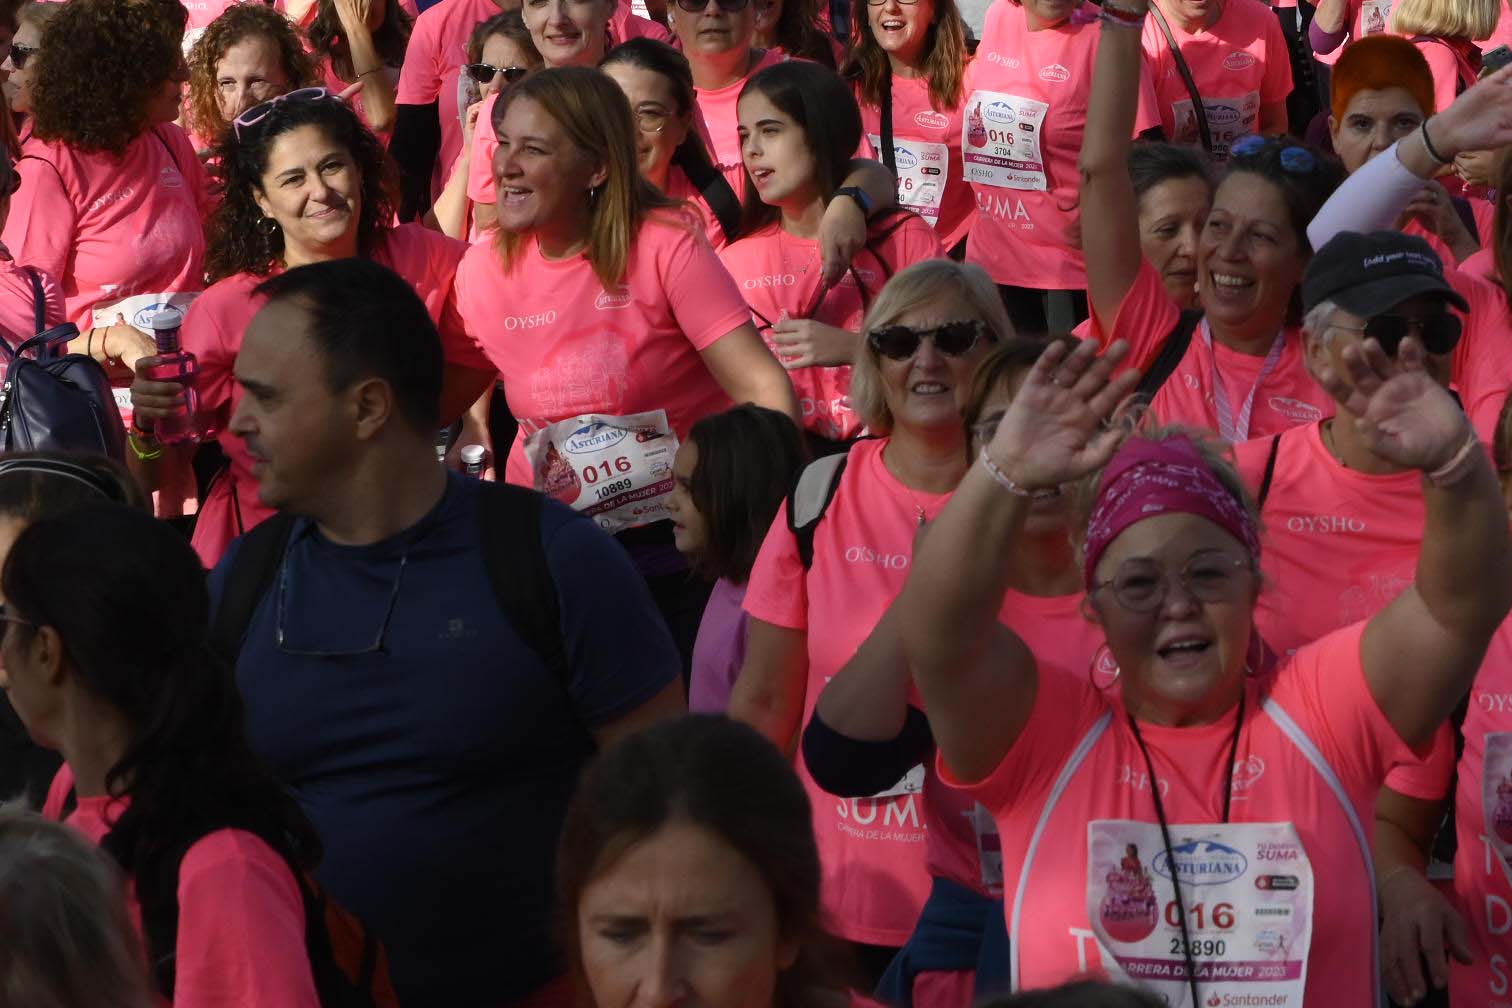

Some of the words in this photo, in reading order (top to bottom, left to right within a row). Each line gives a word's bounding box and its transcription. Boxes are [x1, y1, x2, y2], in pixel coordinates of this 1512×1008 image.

[989, 129, 1015, 145] 016
[994, 146, 1012, 157] 3704
[504, 309, 557, 331] OYSHO
[570, 429, 623, 450] ASTURIANA
[582, 455, 632, 484] 016
[594, 478, 632, 500] 10889
[616, 496, 628, 508] LA
[629, 486, 656, 503] MUJER
[866, 831, 878, 840] DE
[880, 832, 893, 841] LA
[1256, 849, 1299, 862] SUMA
[1164, 900, 1236, 930] 016
[1169, 937, 1226, 957] 2890
[1211, 964, 1254, 977] MUJER
[1223, 993, 1289, 1008] Santander
